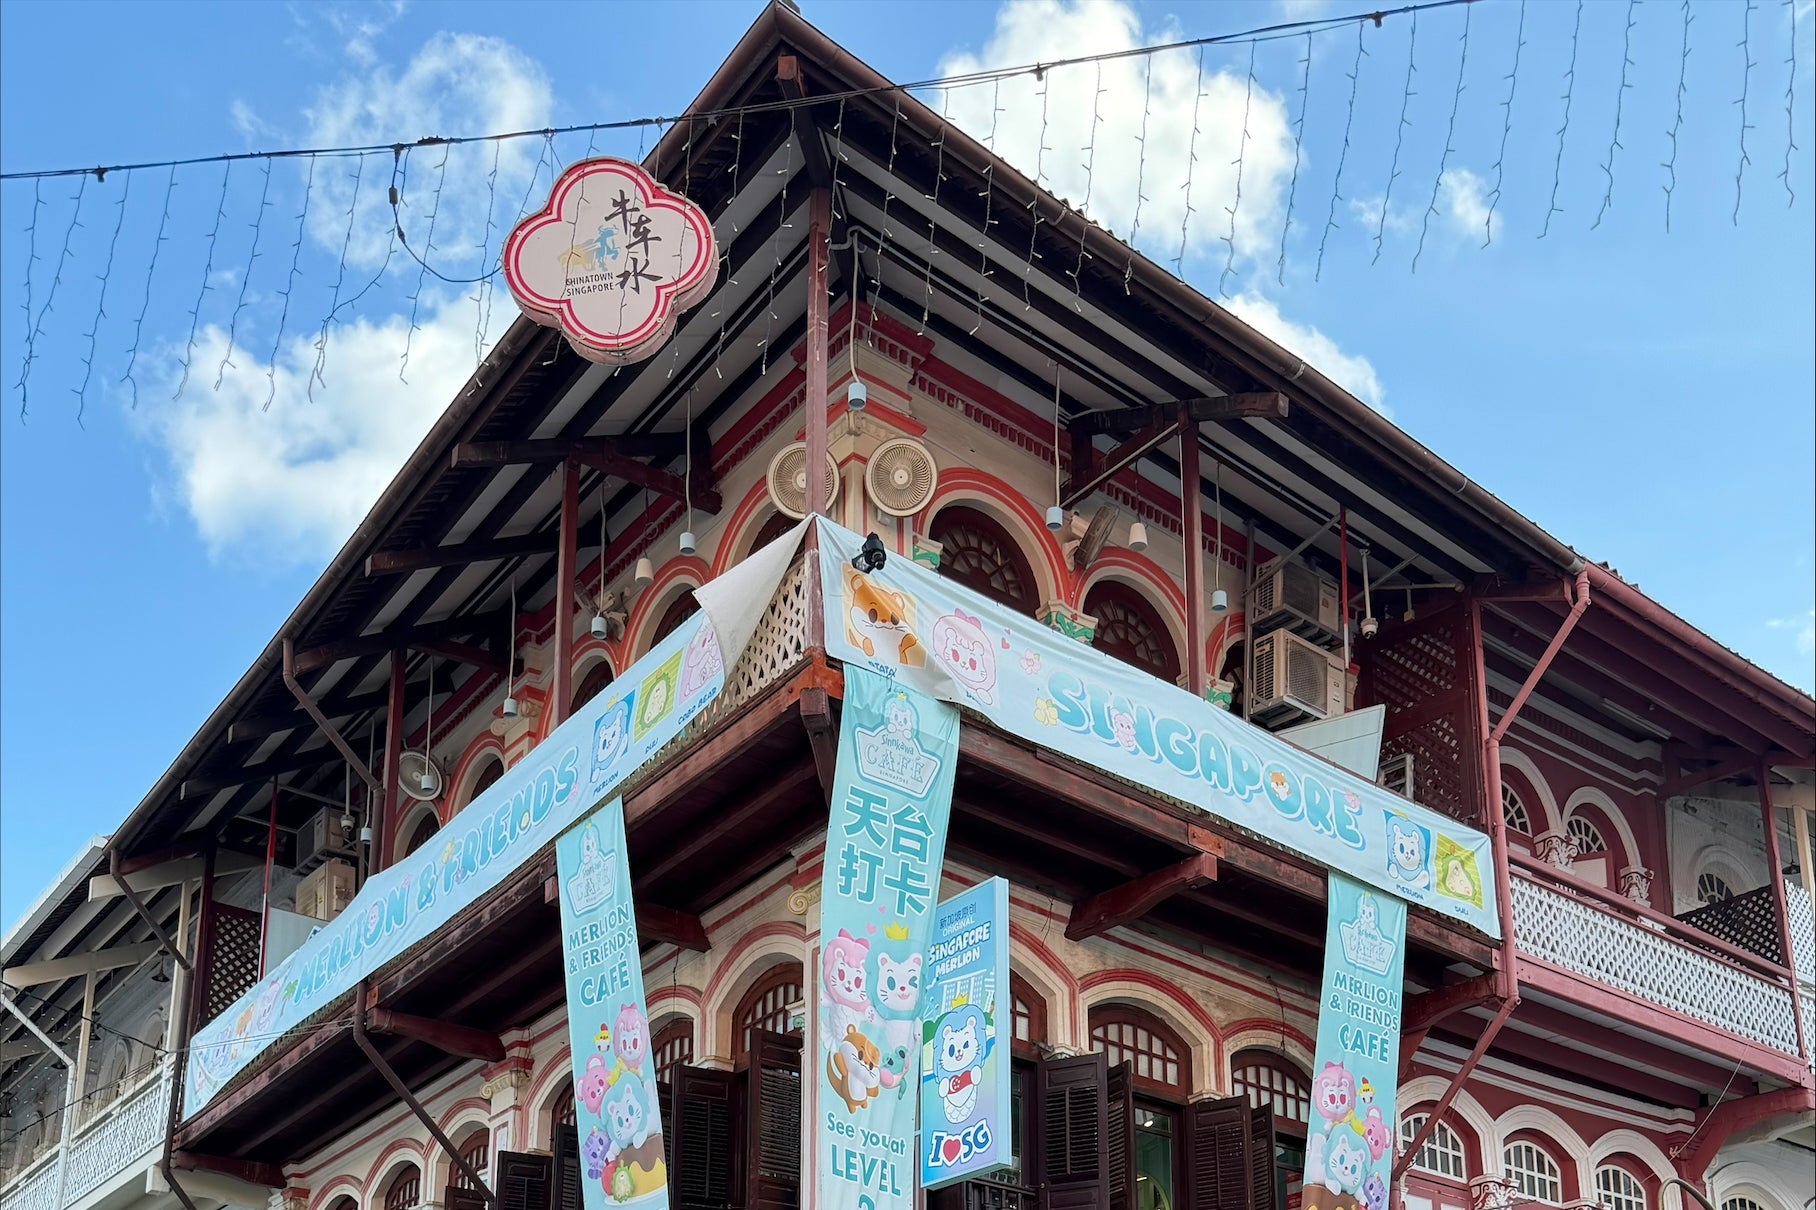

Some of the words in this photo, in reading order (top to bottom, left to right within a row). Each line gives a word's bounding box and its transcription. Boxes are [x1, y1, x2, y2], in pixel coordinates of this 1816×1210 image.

[604, 189, 663, 295] 牛车水
[567, 282, 614, 296] SINGAPORE
[865, 744, 925, 784] CAFÉ
[842, 785, 936, 864] 天台
[293, 885, 412, 1004] MERLION
[416, 860, 438, 915] &
[443, 746, 580, 897] FRIENDS
[837, 842, 932, 917] 打卡
[568, 902, 631, 951] MERLION
[569, 957, 579, 976] &
[582, 926, 635, 969] FRIENDS
[942, 916, 976, 937] ORIGINAL
[580, 952, 631, 1007] CAFÉ
[935, 946, 981, 979] MERLION
[1329, 994, 1342, 1011] &
[1346, 998, 1399, 1032] FRIENDS
[1333, 971, 1399, 1009] MERLION
[1338, 1023, 1389, 1064] CAFÉ
[827, 1111, 855, 1138] See
[859, 1128, 891, 1148] you
[890, 1136, 906, 1155] at
[929, 1132, 945, 1168] I
[960, 1118, 992, 1161] SG
[831, 1143, 902, 1197] LEVEL
